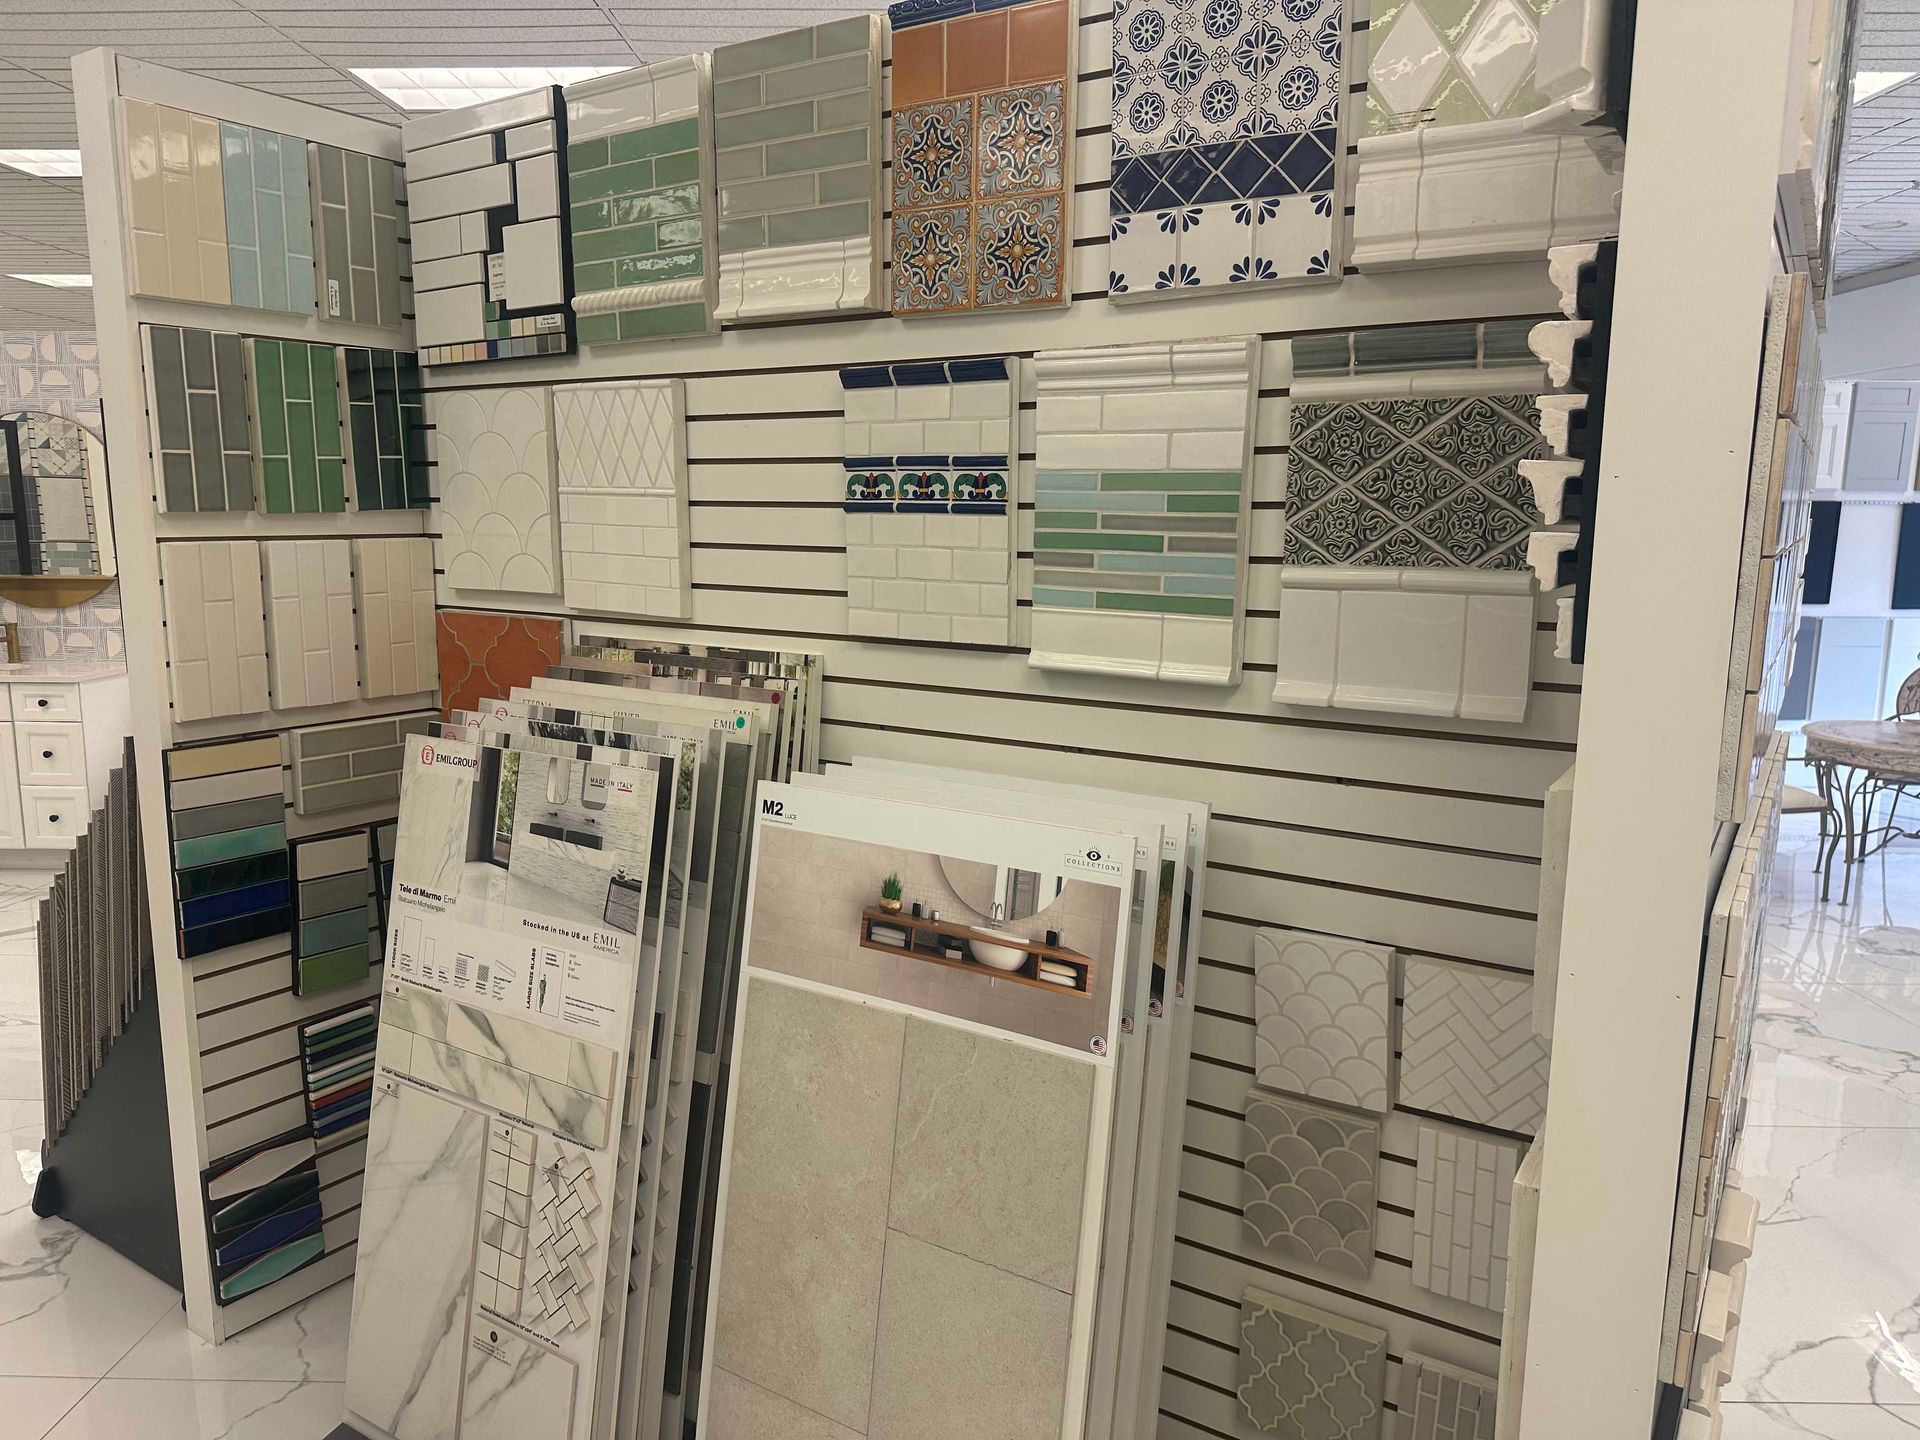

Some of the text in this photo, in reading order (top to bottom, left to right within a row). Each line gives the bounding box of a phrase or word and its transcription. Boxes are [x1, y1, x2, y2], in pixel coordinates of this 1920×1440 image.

[436, 753, 478, 768] EMILGROUP
[590, 777, 606, 786] MADE
[617, 781, 633, 790] ITALY
[762, 799, 784, 816] M2
[784, 813, 798, 821] LUCE
[1066, 857, 1121, 872] COLLECTIONS
[399, 883, 412, 894] Tele
[412, 887, 419, 896] di
[420, 888, 442, 902] Marmo
[522, 919, 549, 932] Stocked
[558, 929, 570, 937] the
[571, 931, 580, 940] US
[593, 932, 621, 949] EMIL
[592, 944, 620, 955] AMERICA
